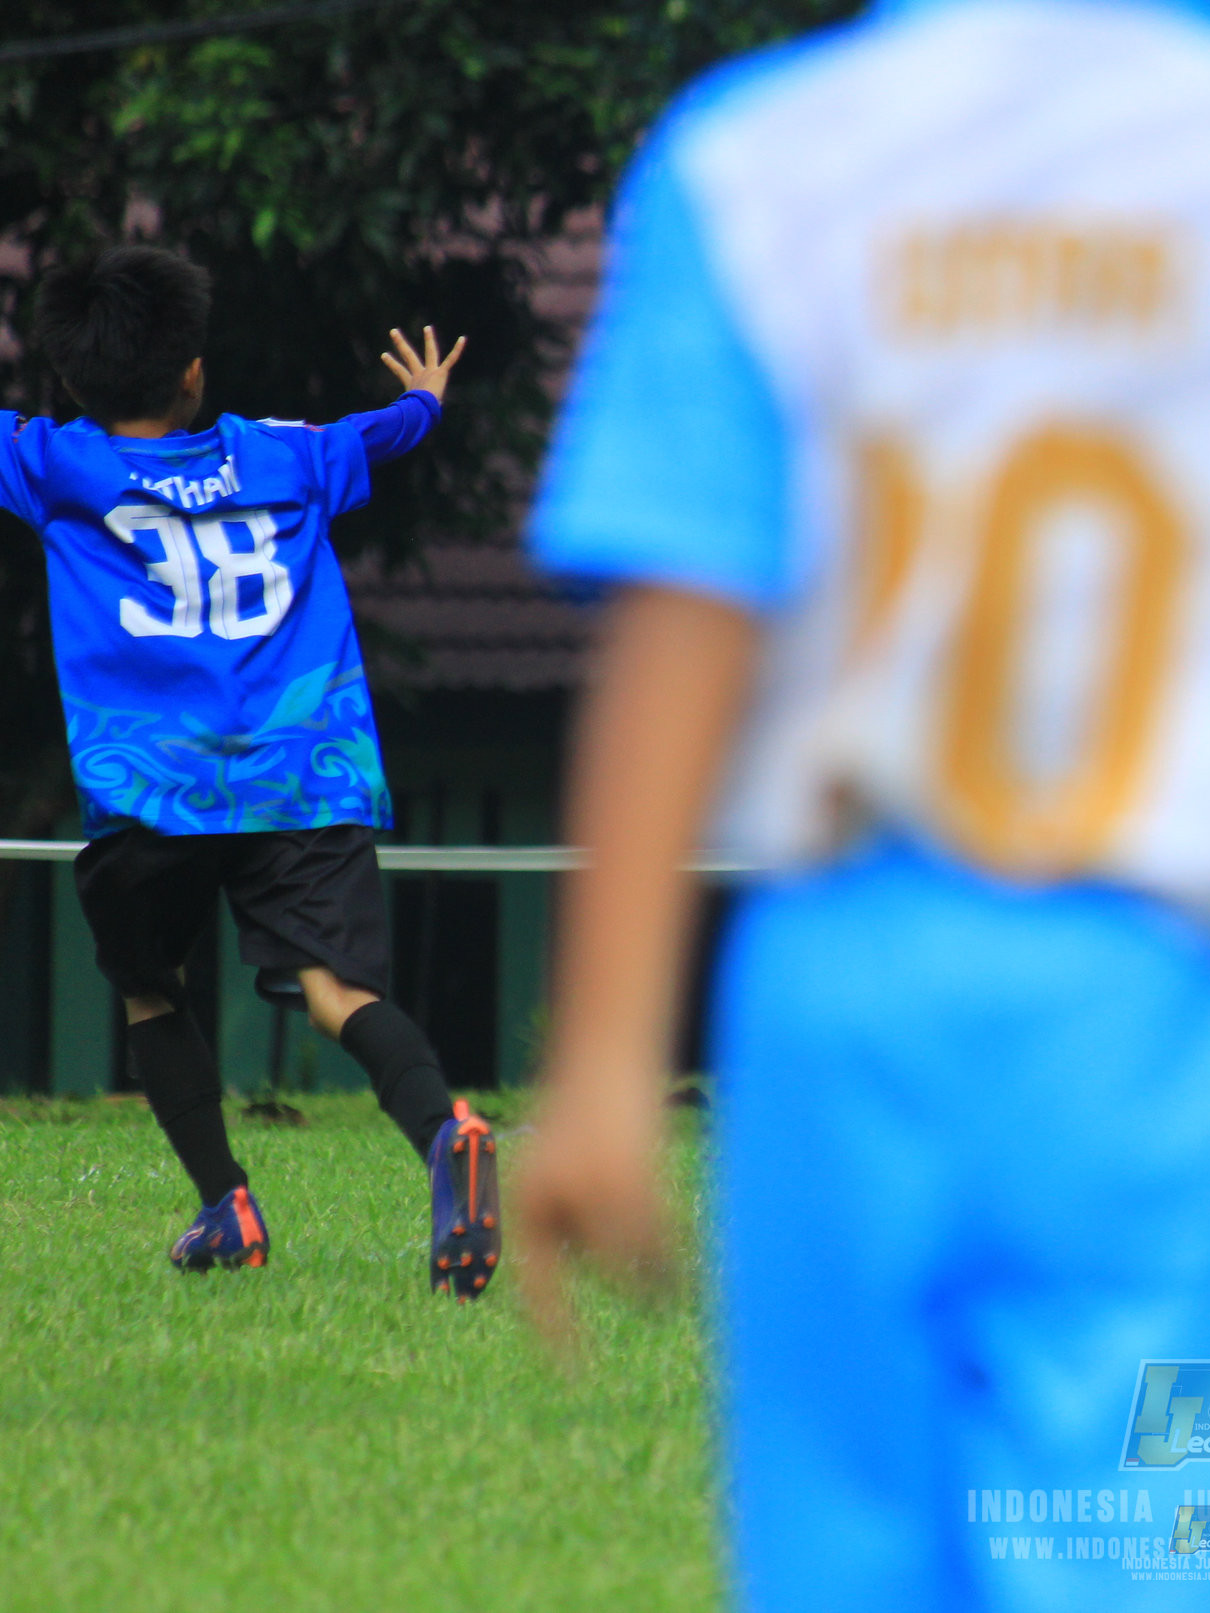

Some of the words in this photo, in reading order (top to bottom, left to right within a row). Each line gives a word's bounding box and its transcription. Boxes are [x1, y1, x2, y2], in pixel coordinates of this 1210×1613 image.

[129, 454, 241, 508] THAN
[104, 504, 293, 640] 38
[845, 412, 1203, 880] 0
